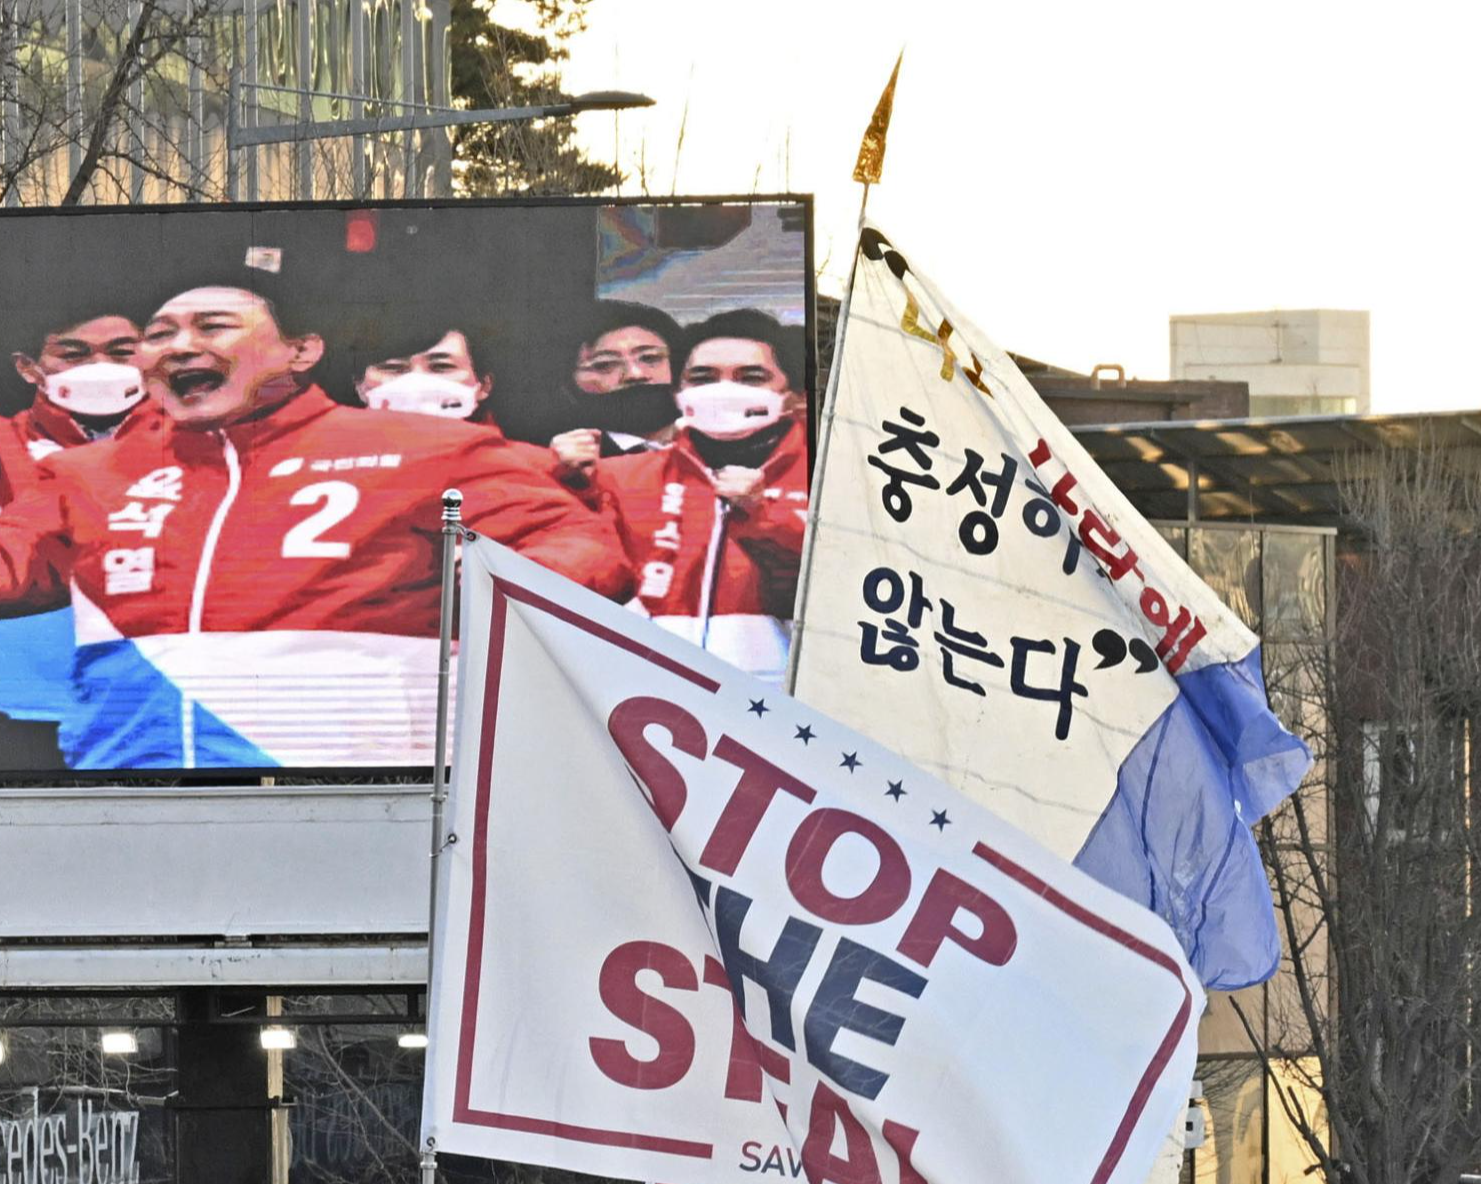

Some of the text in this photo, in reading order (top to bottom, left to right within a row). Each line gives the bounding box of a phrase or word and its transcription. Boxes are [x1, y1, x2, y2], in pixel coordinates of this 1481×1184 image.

[282, 481, 361, 558] 2
[607, 696, 1018, 967] STOP
[695, 865, 928, 1101] HE
[739, 1140, 804, 1177] SAV
